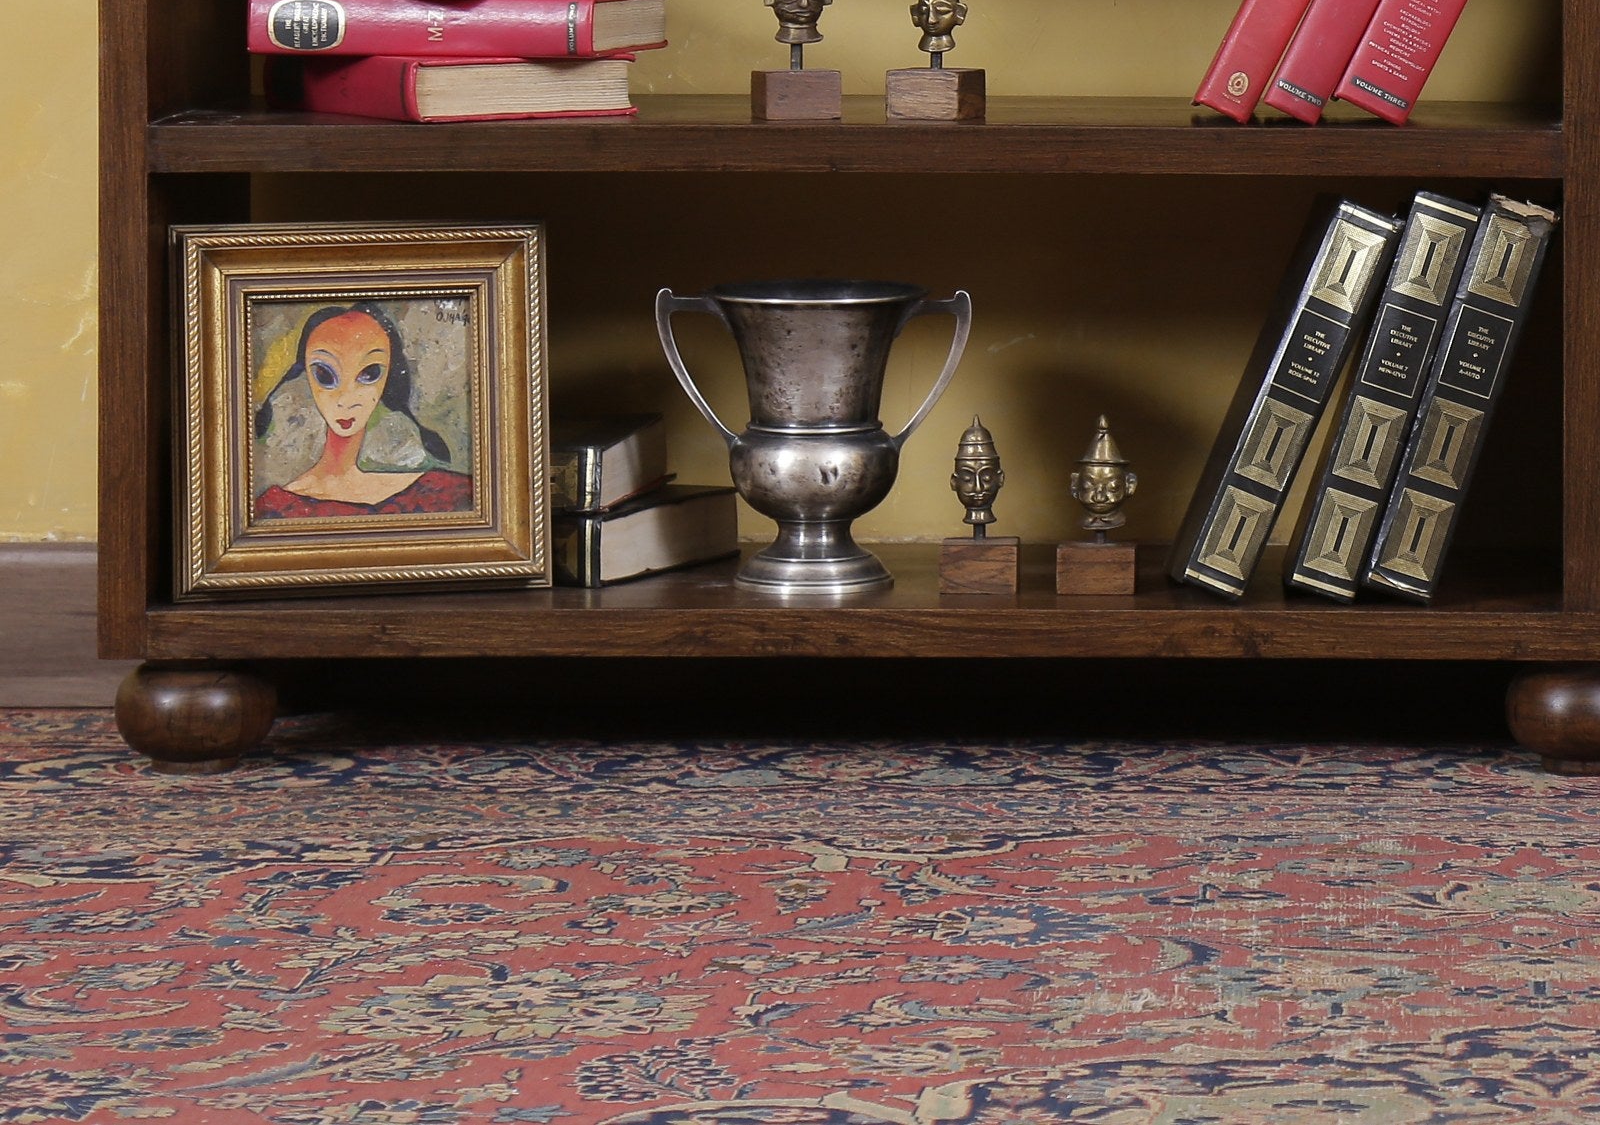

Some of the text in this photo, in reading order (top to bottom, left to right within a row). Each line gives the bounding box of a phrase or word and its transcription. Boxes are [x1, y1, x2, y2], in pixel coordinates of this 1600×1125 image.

[284, 19, 292, 30] THE
[428, 10, 444, 42] M-Z
[568, 22, 576, 51] VOLUME
[1371, 59, 1388, 70] SPORTS
[1279, 79, 1322, 106] VOLUME TWO
[1356, 78, 1407, 108] VOLUME THREE
[1401, 324, 1412, 333] THE
[1390, 329, 1418, 343] EXECUTIVE
[1390, 337, 1412, 349] LIBRARY
[1381, 358, 1404, 370] VOLUME
